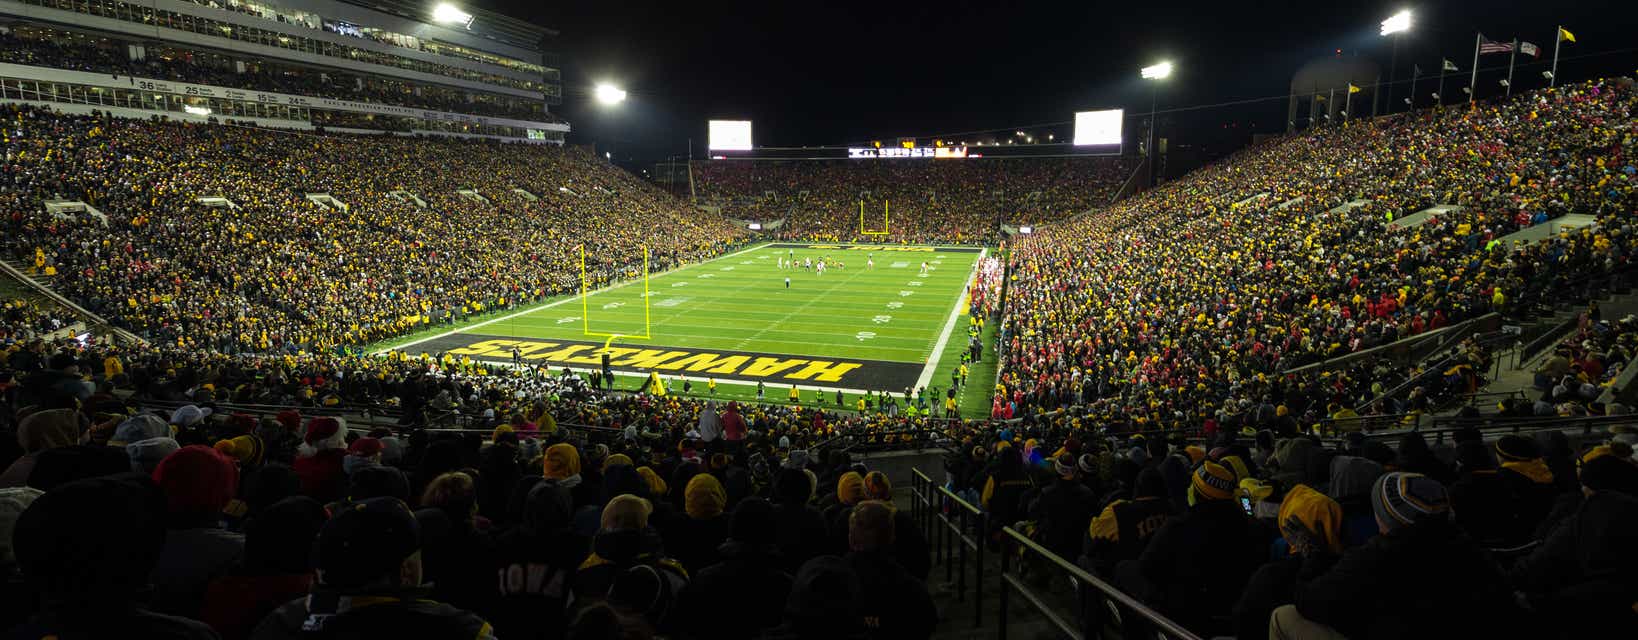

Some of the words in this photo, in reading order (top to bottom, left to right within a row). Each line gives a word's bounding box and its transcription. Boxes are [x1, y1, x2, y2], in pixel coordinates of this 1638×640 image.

[139, 81, 154, 90] 36
[185, 86, 198, 95] 25
[225, 90, 232, 98] 2
[257, 94, 267, 102] 15
[288, 97, 299, 105] 24
[447, 339, 862, 382] HAWKEYES
[497, 562, 563, 597] IOWA
